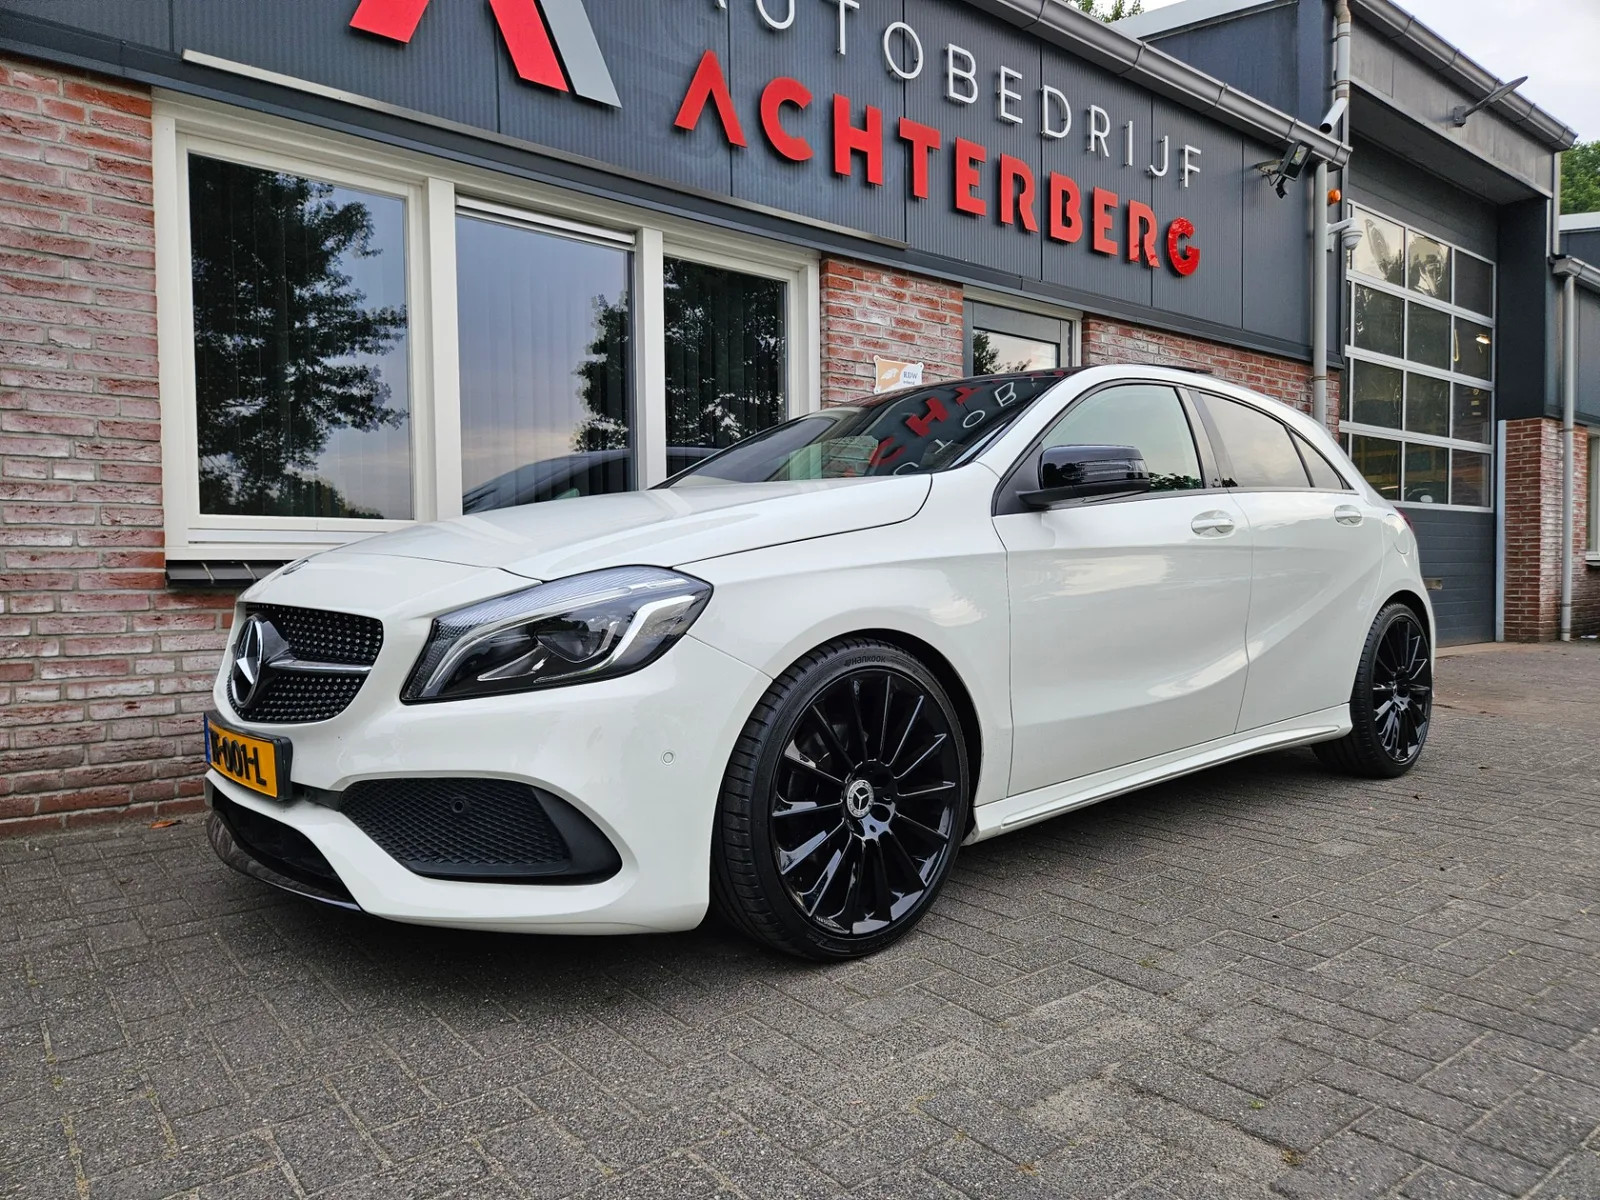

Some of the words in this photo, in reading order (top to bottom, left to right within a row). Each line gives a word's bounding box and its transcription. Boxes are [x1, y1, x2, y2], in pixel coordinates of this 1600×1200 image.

[674, 50, 1200, 276] ACHTERBERG
[718, 0, 1202, 188] TOBEDRIJF
[903, 371, 918, 379] RDW
